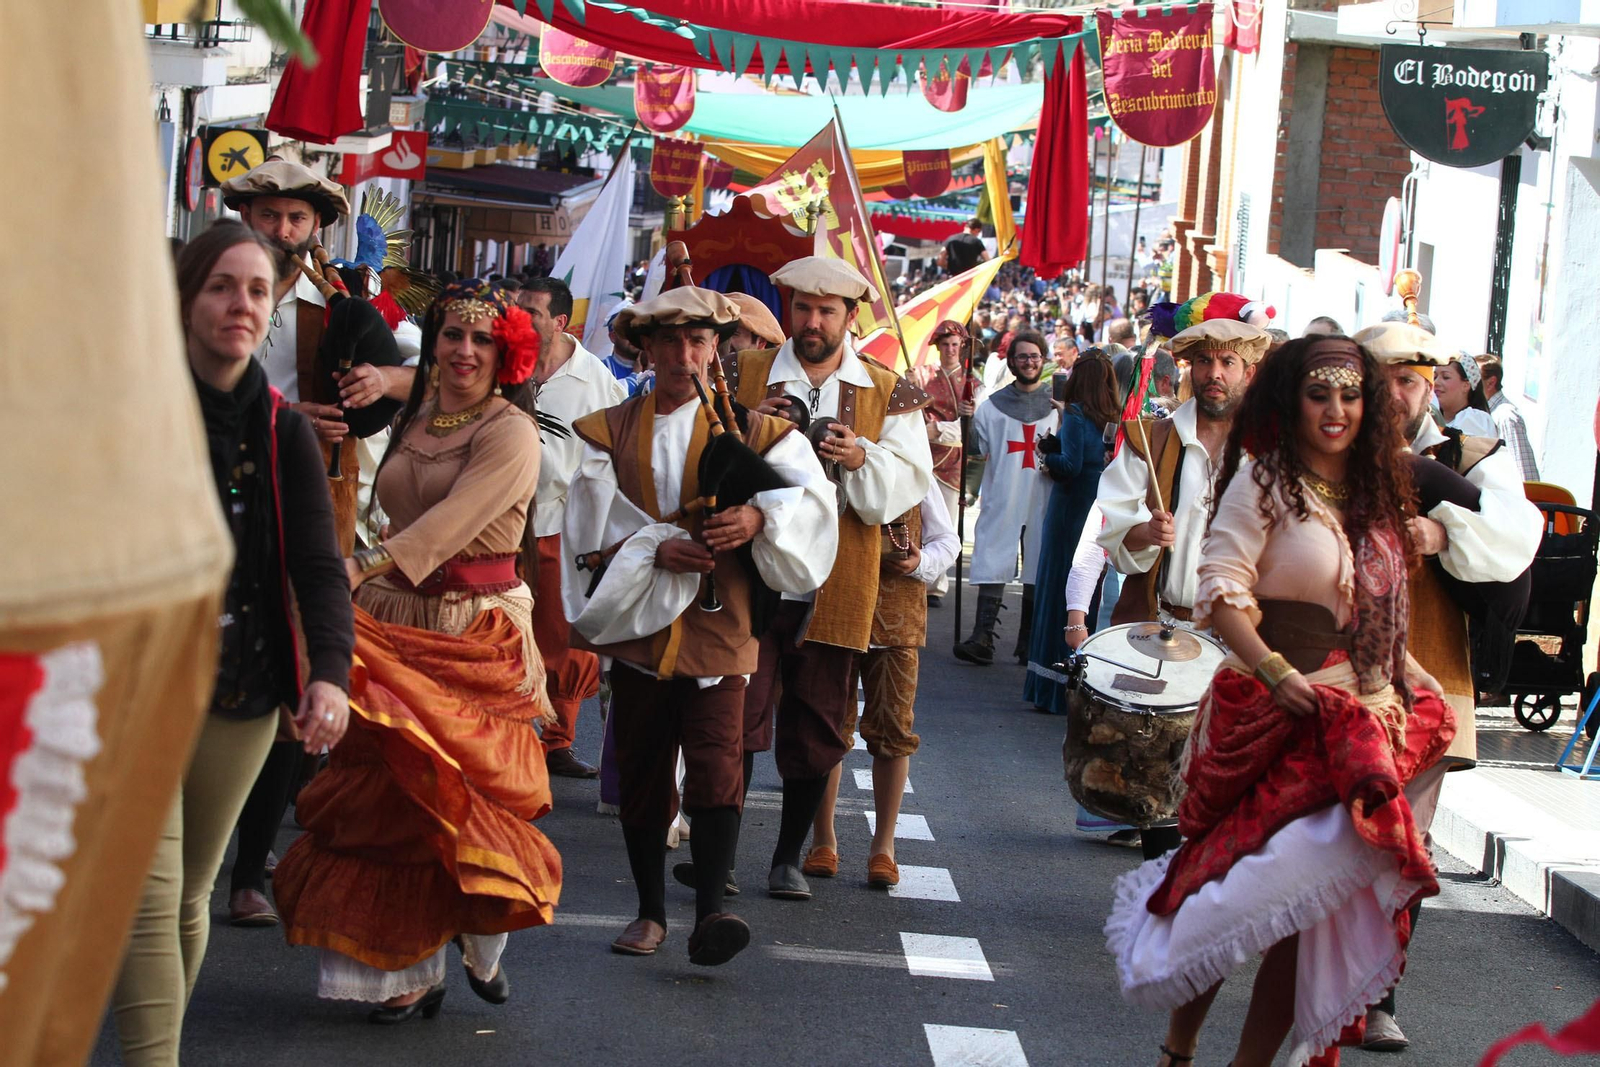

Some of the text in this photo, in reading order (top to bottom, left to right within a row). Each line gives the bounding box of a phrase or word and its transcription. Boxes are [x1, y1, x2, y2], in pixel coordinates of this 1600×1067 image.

[1105, 28, 1213, 57] Feria Medieval
[1151, 57, 1173, 79] del
[1393, 59, 1536, 94] El Bodegón
[1109, 86, 1215, 115] Descubrimiento
